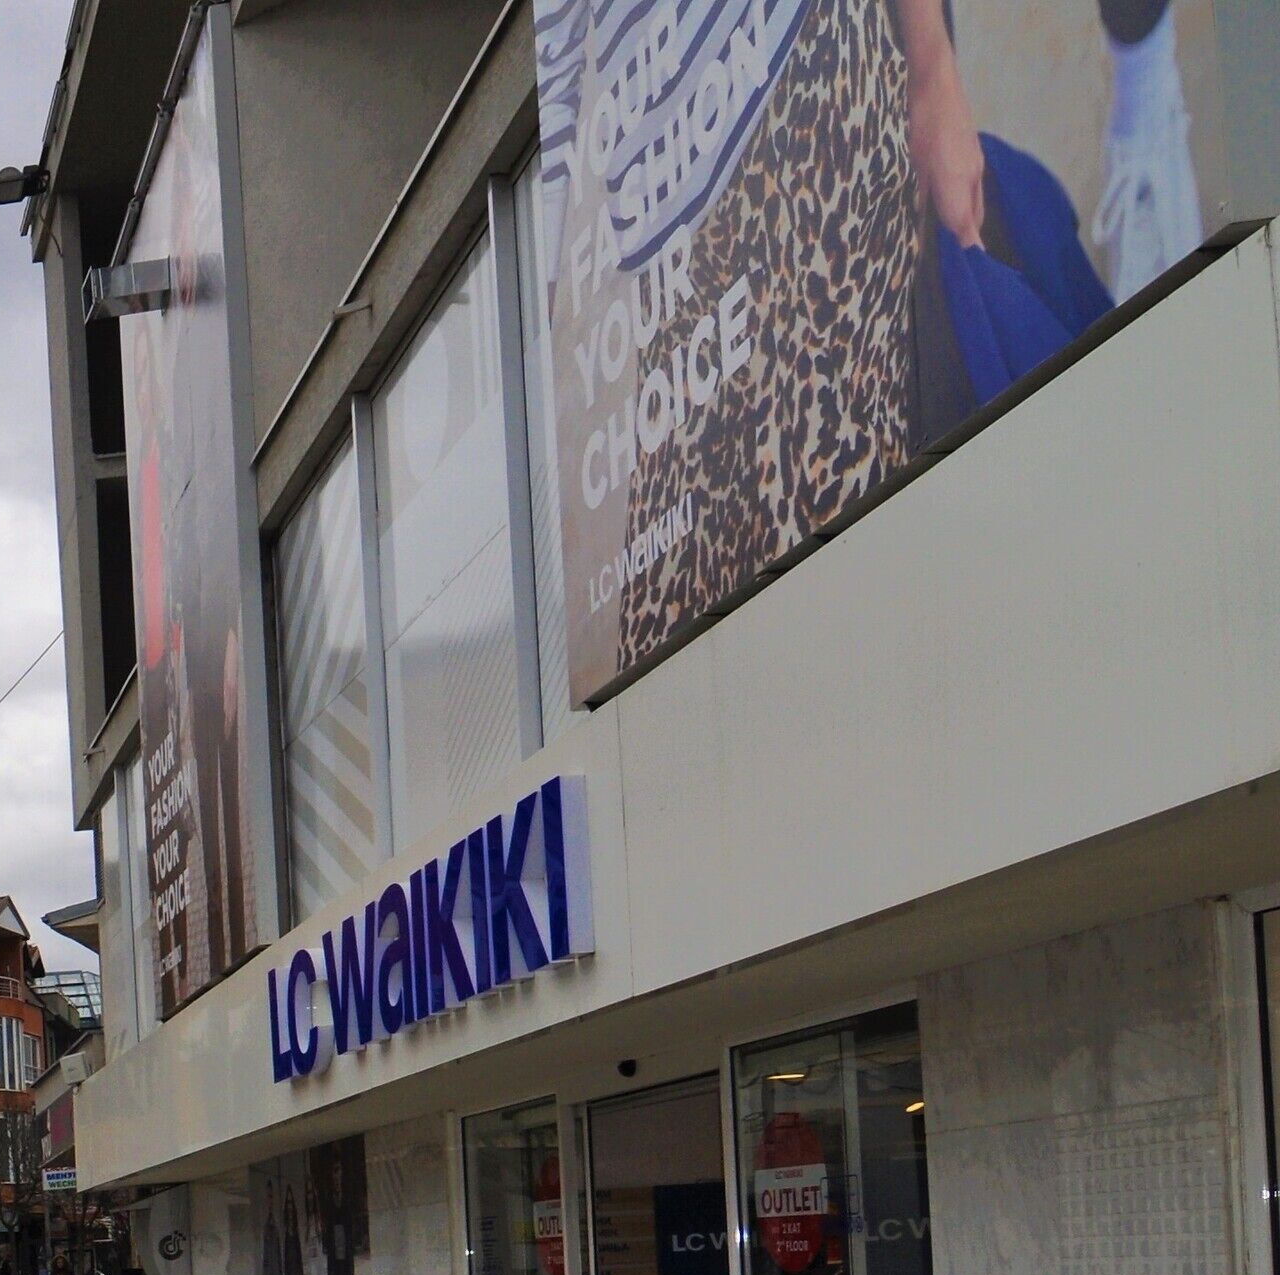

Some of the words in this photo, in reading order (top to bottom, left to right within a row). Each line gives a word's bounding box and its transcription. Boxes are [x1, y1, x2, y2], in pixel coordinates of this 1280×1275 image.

[567, 4, 682, 206] YOUR
[570, 0, 769, 318] FASHION
[574, 224, 694, 408] YOUR
[581, 274, 751, 510] CHOICE
[590, 565, 614, 614] LC
[148, 731, 175, 792] YOUR
[151, 765, 191, 840] FASHION
[153, 829, 180, 884] YOUR
[155, 868, 191, 932] CHOICE
[268, 949, 319, 1083] LC
[538, 1216, 563, 1236] OUTL
[761, 1186, 820, 1214] OUTLET
[671, 1233, 706, 1252] LC
